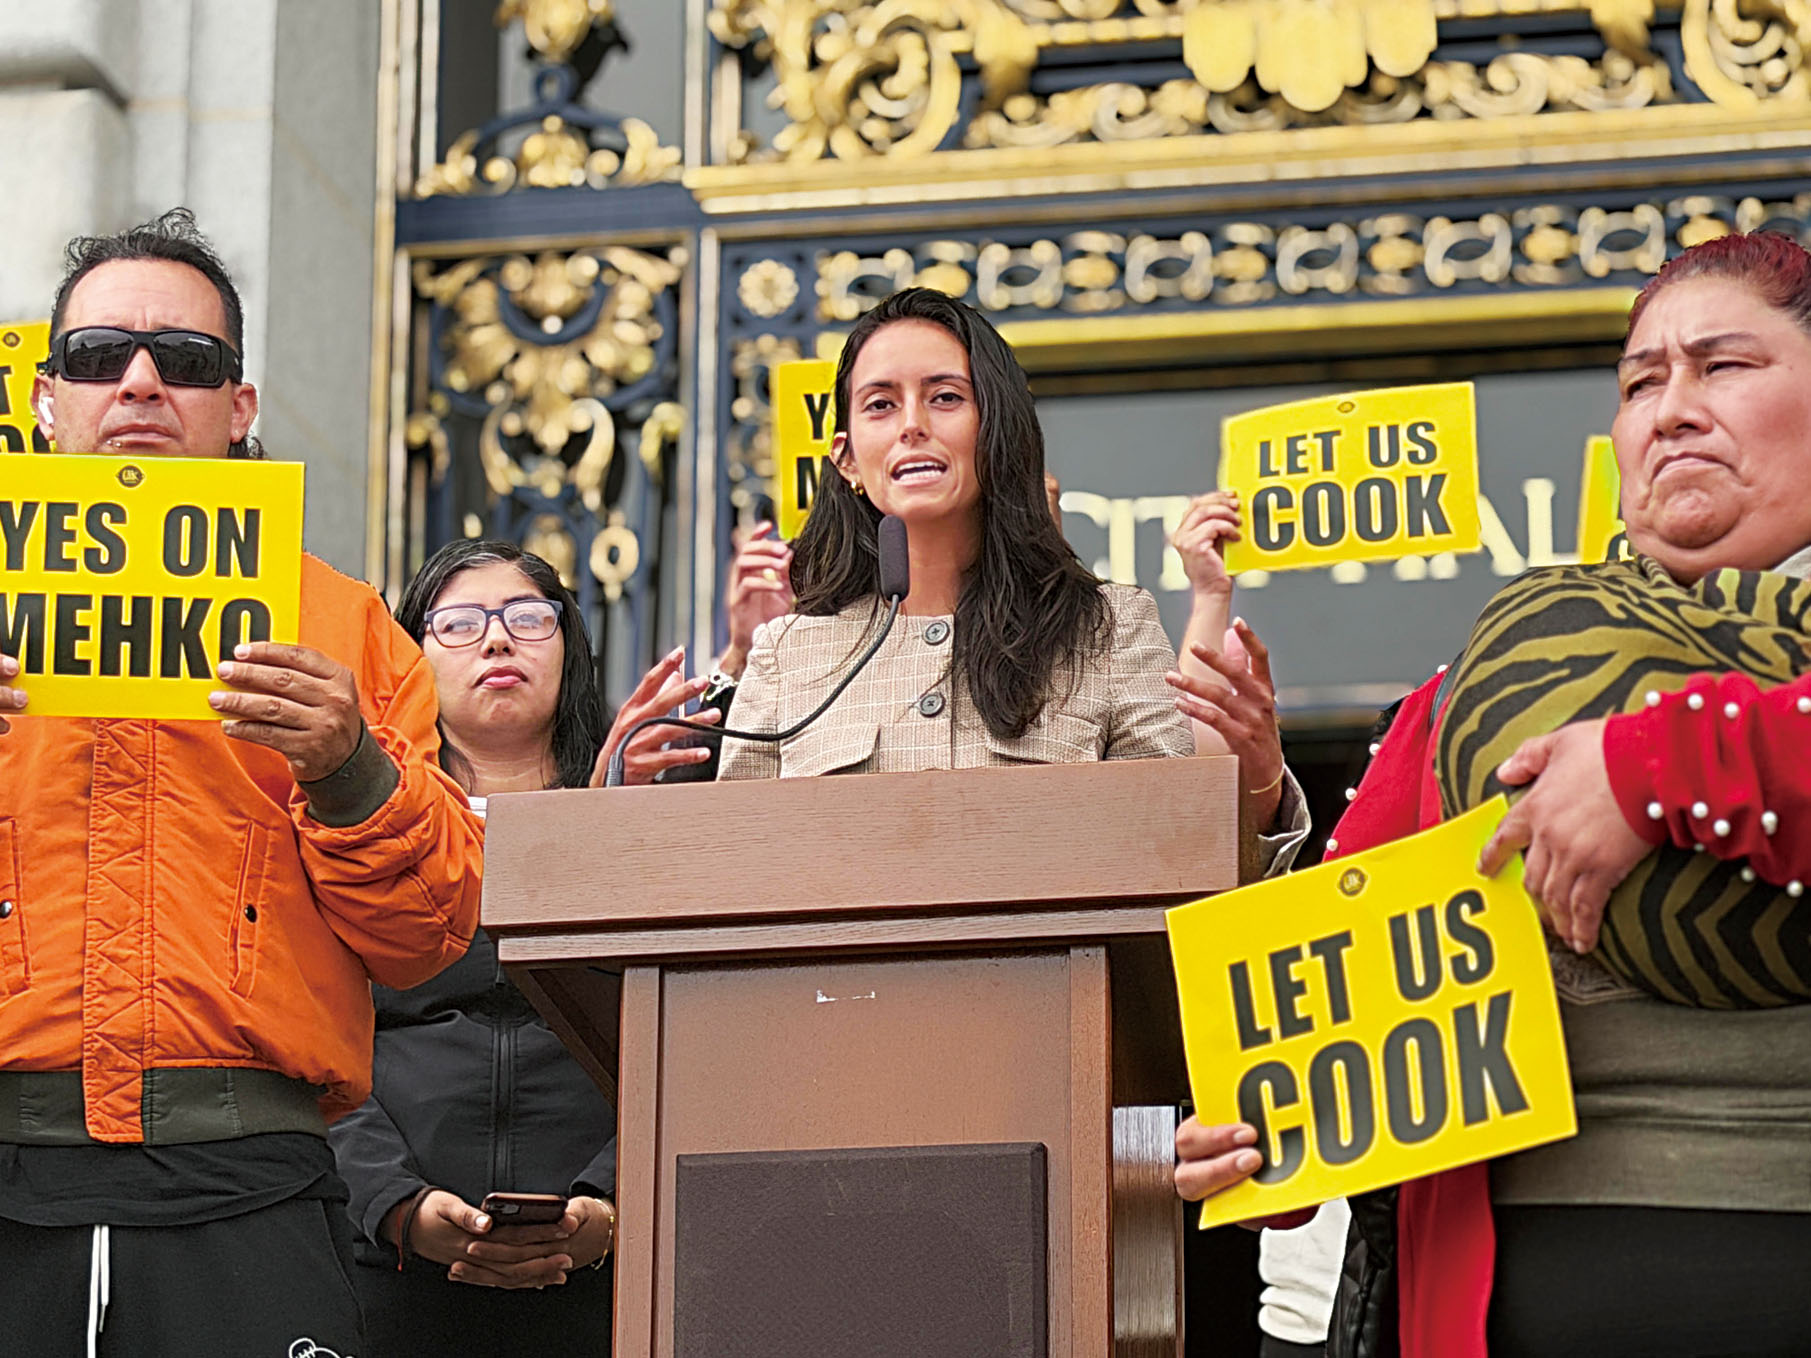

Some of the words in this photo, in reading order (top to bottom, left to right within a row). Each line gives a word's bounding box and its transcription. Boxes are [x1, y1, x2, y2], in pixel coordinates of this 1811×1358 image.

[1260, 430, 1341, 478] LET
[1368, 421, 1437, 468] US
[0, 501, 127, 574] YES
[163, 505, 260, 578] ON
[1252, 473, 1452, 551] COOK
[0, 592, 271, 680] MEHKO
[1228, 930, 1353, 1051] LET
[1388, 889, 1494, 1001] US
[1237, 990, 1531, 1184] COOK
